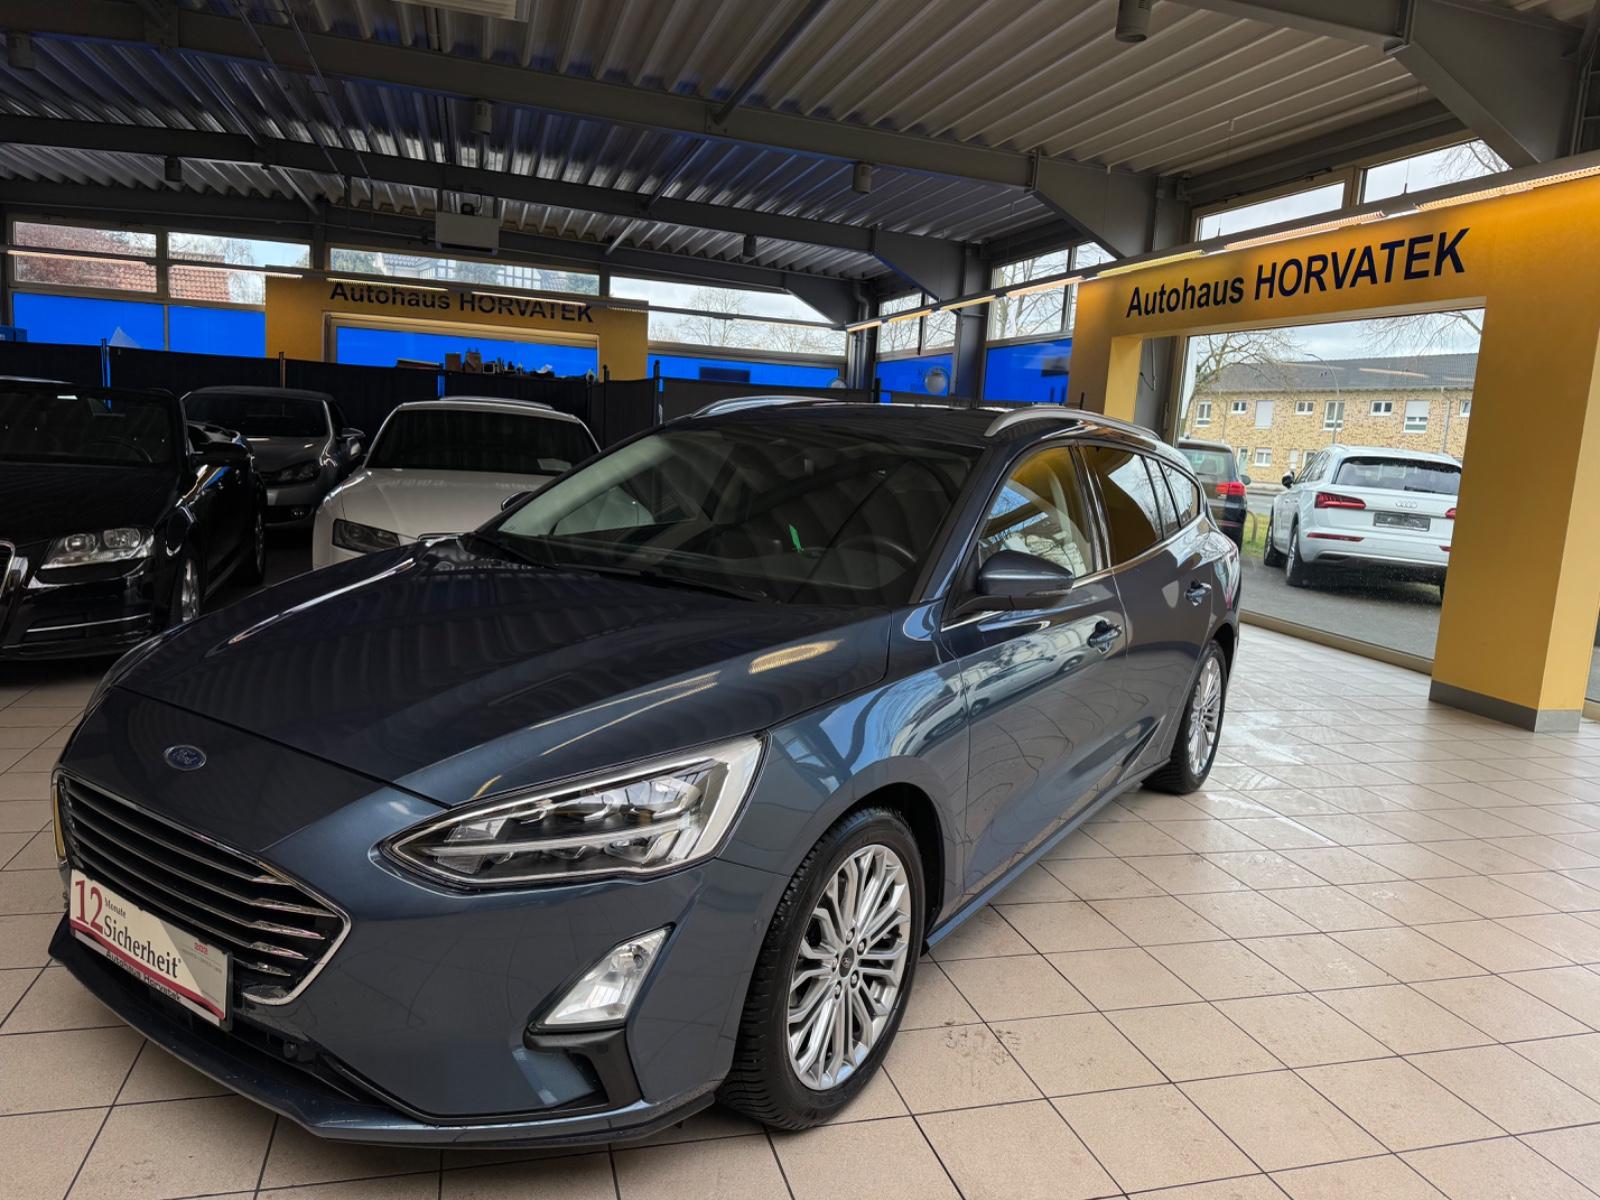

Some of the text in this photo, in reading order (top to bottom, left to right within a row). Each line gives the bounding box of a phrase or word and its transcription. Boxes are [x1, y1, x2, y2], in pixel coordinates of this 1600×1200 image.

[330, 281, 593, 323] Autohaus HORVATEK
[1126, 228, 1469, 318] Autohaus HORVATEK
[75, 879, 104, 934] 12
[103, 915, 179, 979] Sicherheit
